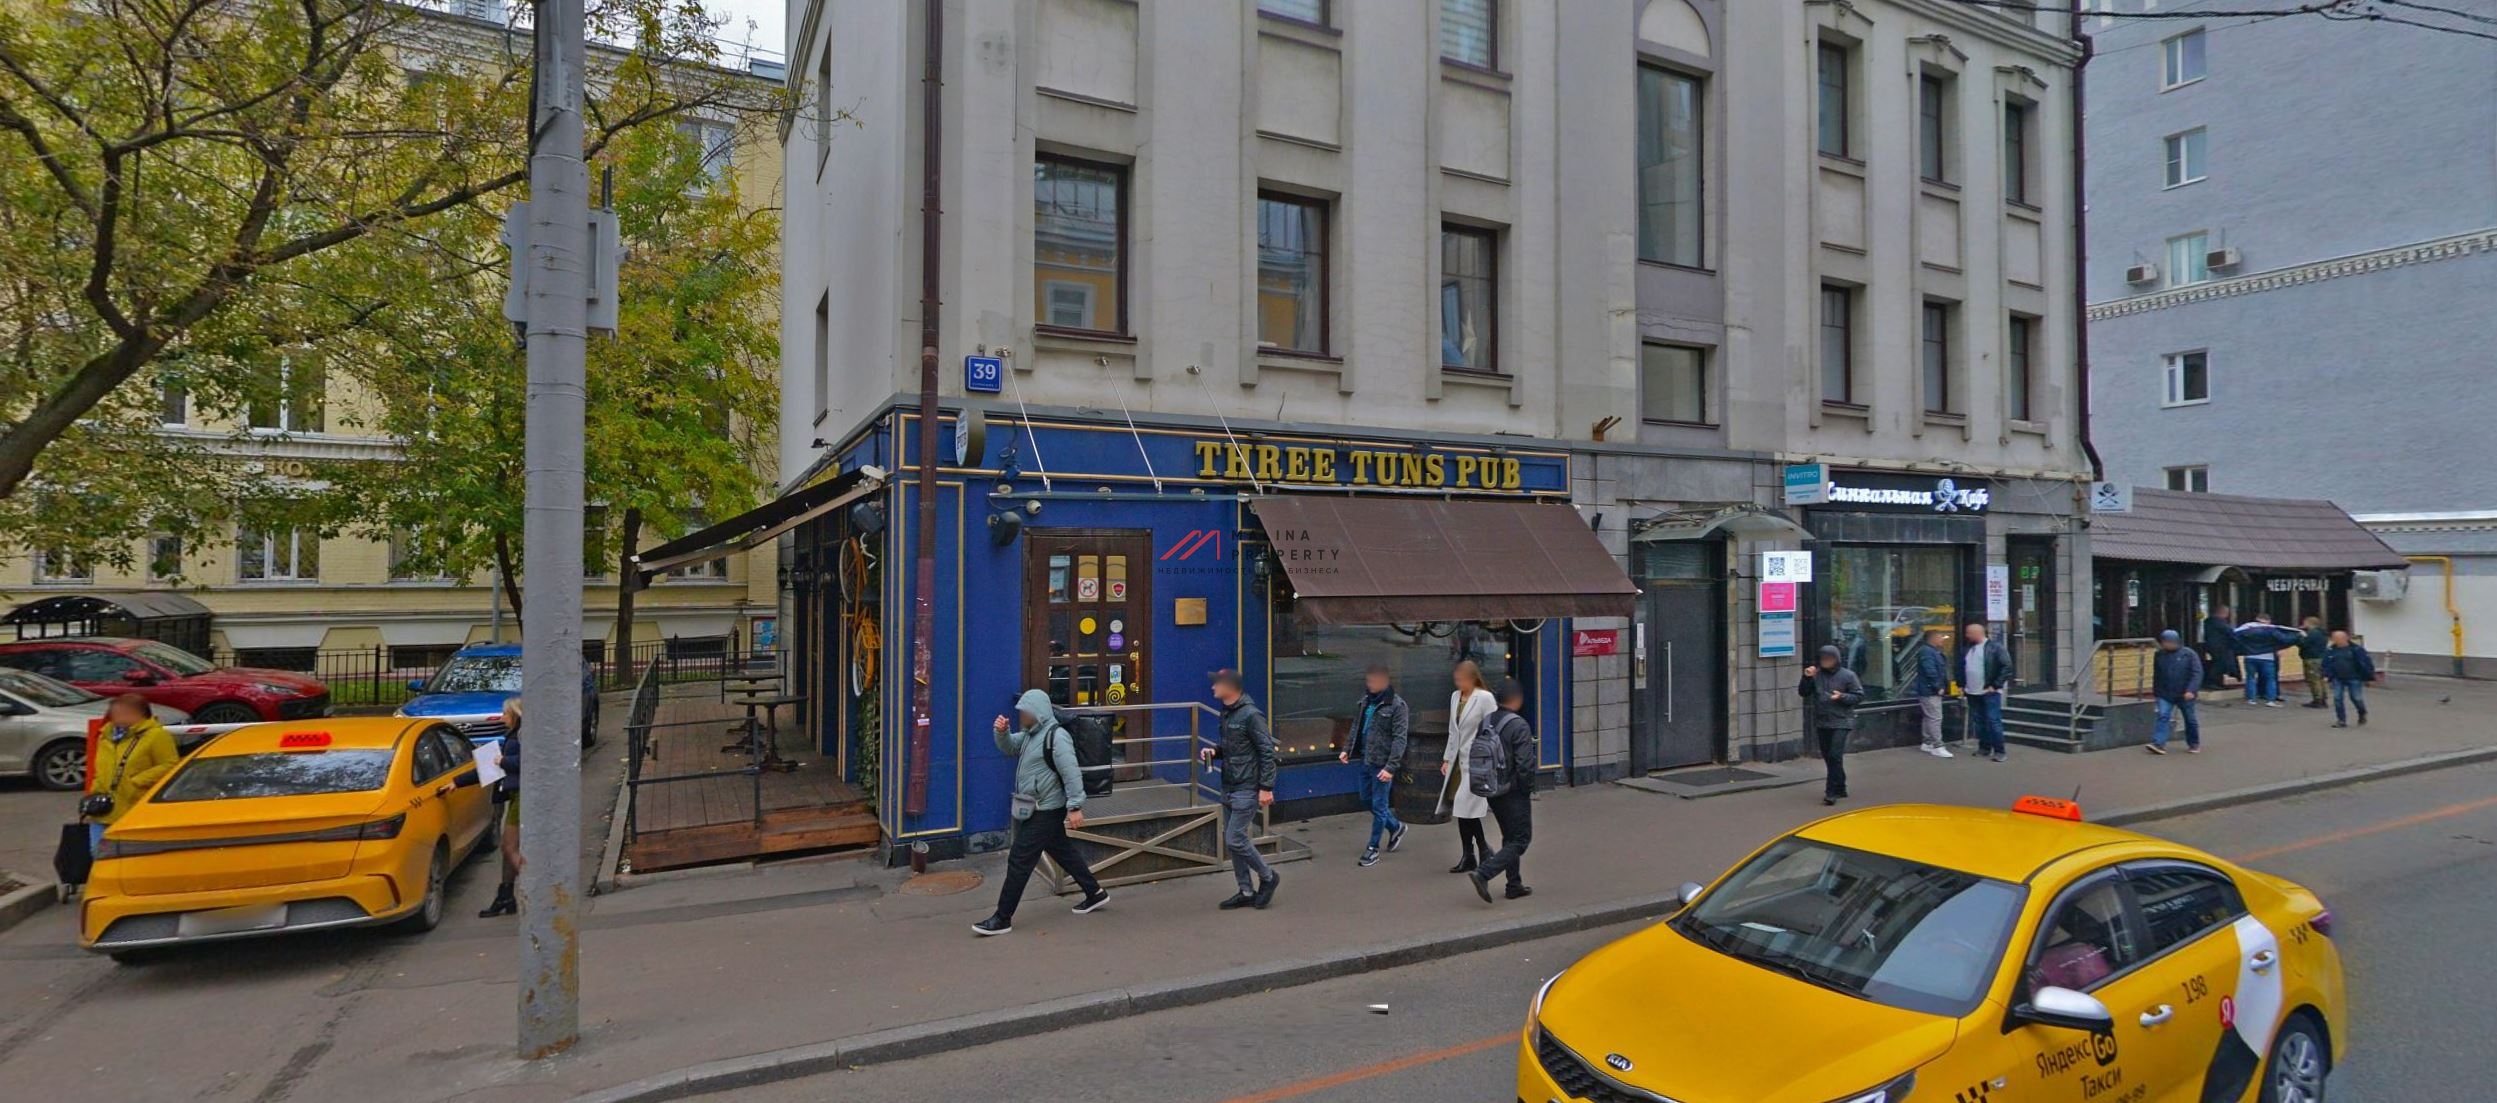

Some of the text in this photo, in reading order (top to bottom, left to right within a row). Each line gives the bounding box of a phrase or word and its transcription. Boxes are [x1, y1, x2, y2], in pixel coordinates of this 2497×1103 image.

[973, 363, 997, 380] 39
[1196, 440, 1521, 489] THREE TUNS PUB
[2266, 579, 2330, 592] ЧЕБУРЕЧНАЯ
[2181, 974, 2209, 1005] 198
[1607, 1055, 1627, 1069] KIA
[2036, 1038, 2092, 1079] Яндекс
[2080, 1066, 2122, 1101] Такси
